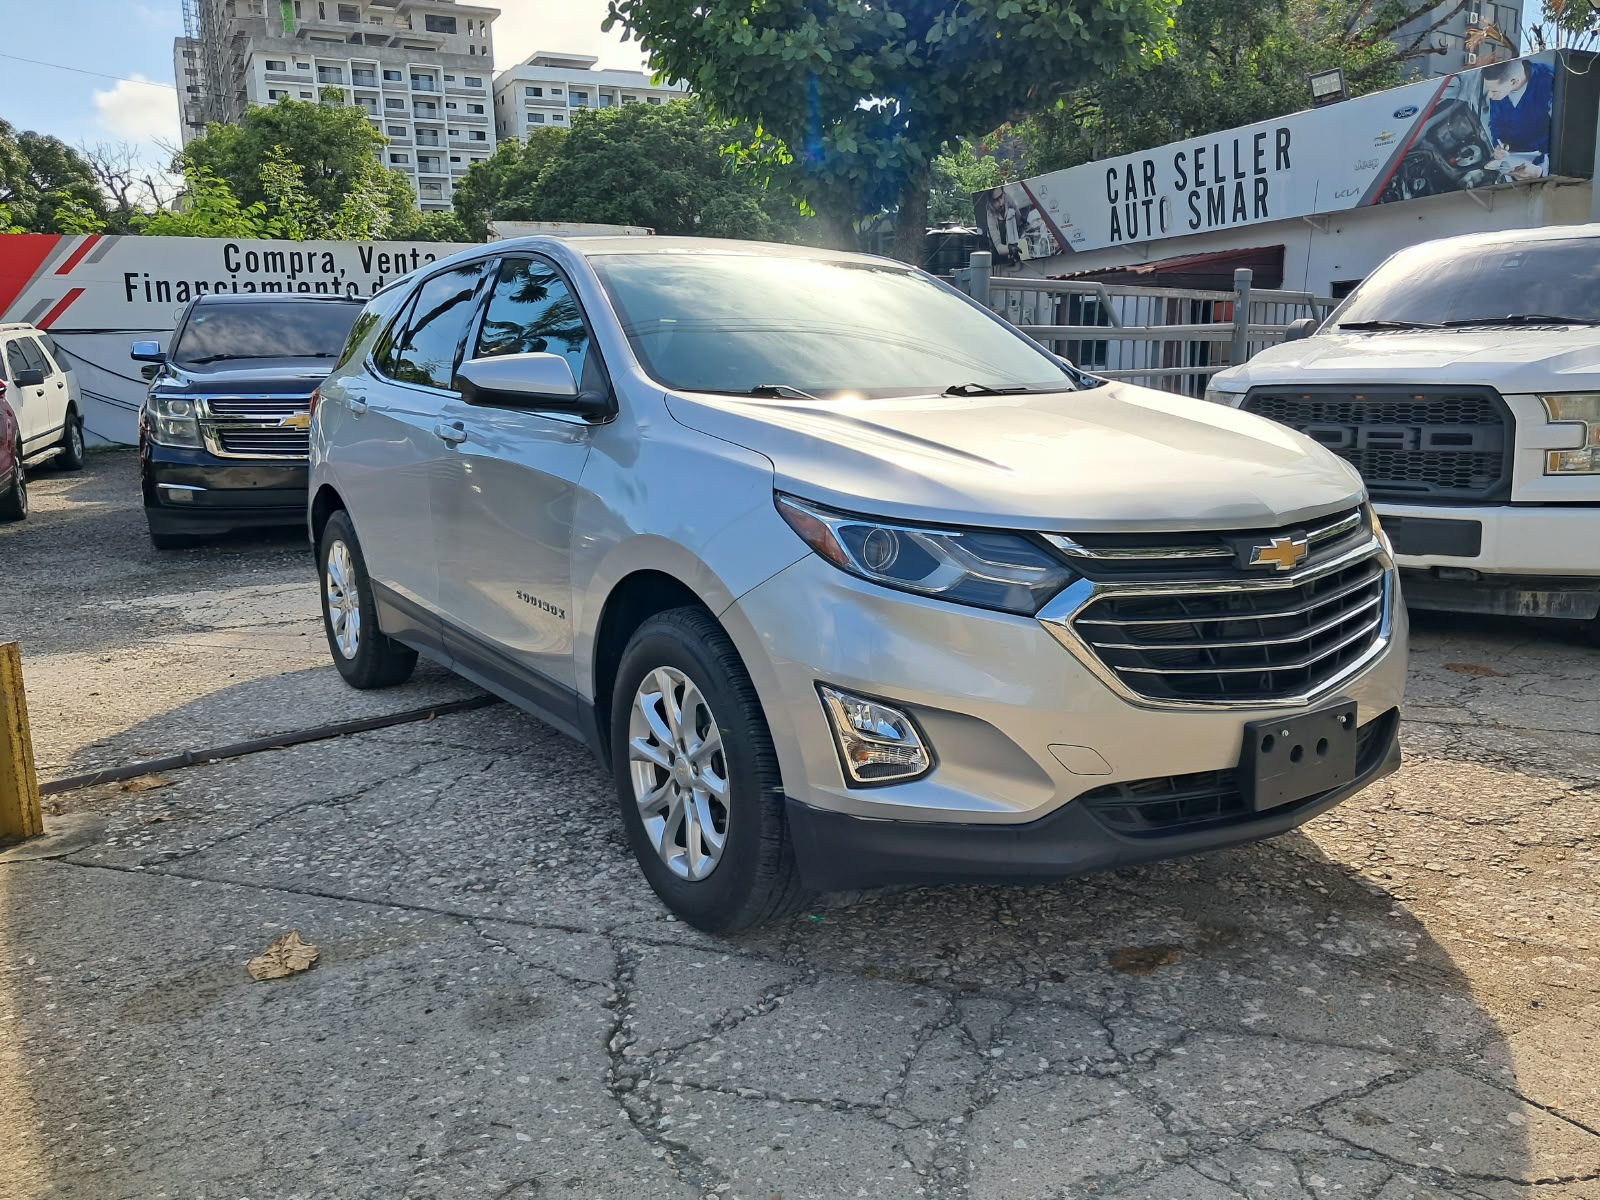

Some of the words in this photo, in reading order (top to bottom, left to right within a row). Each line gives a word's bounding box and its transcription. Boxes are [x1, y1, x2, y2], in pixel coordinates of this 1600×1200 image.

[1106, 159, 1156, 204] CAR
[1173, 127, 1291, 191] SELLER
[1354, 158, 1379, 171] Jeep
[1110, 196, 1172, 242] AUTO
[223, 243, 346, 278] Compra,
